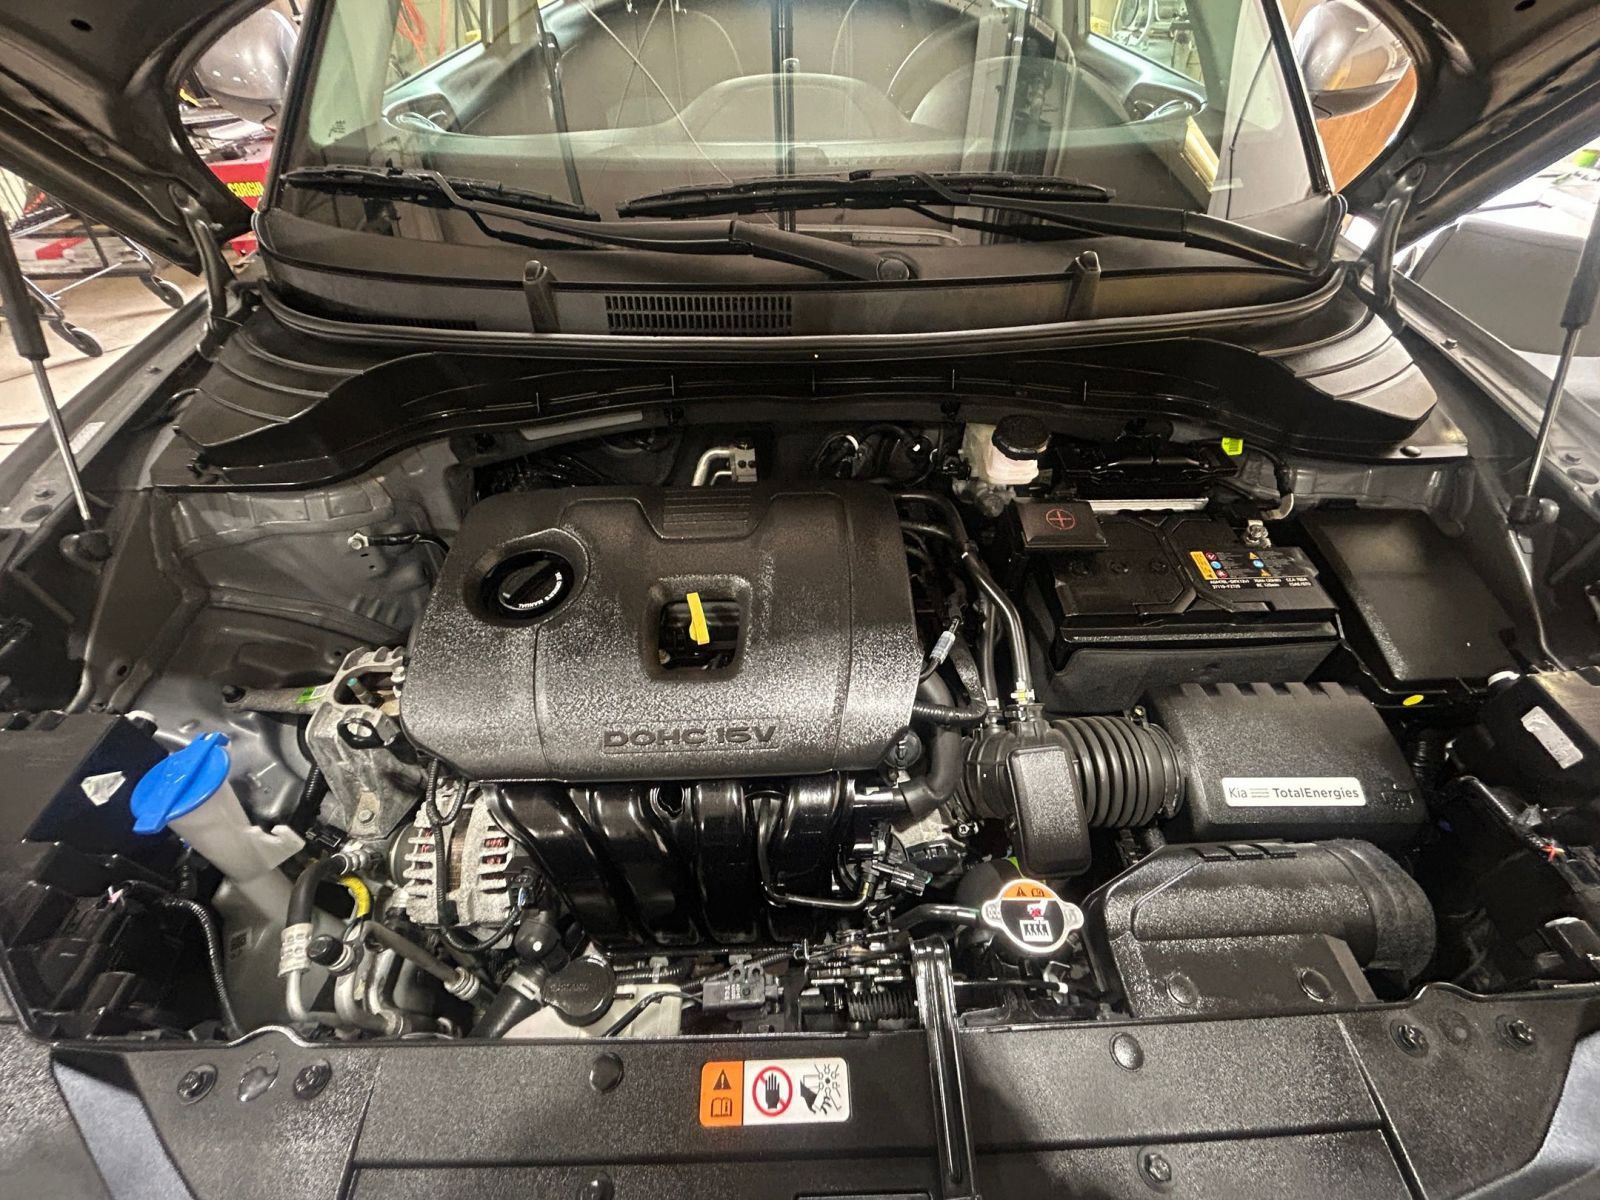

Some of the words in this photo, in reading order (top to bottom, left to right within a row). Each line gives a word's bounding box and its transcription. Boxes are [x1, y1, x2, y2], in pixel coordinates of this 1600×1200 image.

[603, 728, 706, 747] DOHC
[715, 725, 777, 744] 16V
[1228, 787, 1248, 799] Kia
[1272, 787, 1359, 800] TotalEnergies
